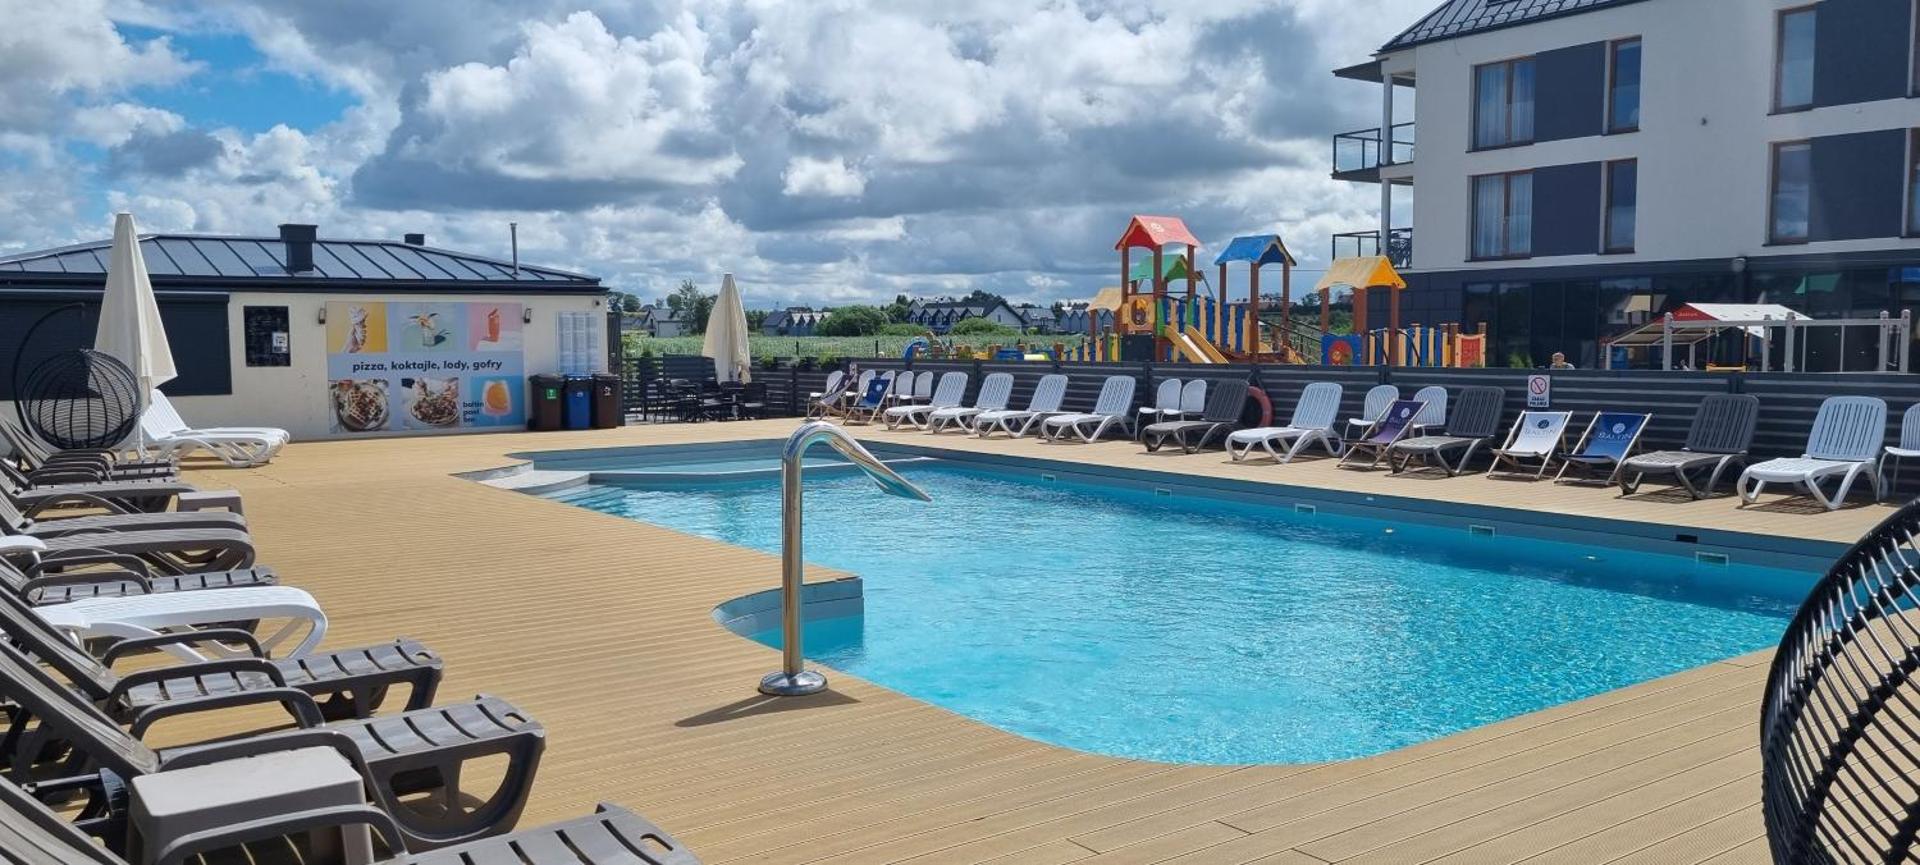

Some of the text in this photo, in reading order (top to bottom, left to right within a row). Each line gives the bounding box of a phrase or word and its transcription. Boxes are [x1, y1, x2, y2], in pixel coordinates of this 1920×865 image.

[352, 359, 502, 373] pizza, koktajle, lody, gofry
